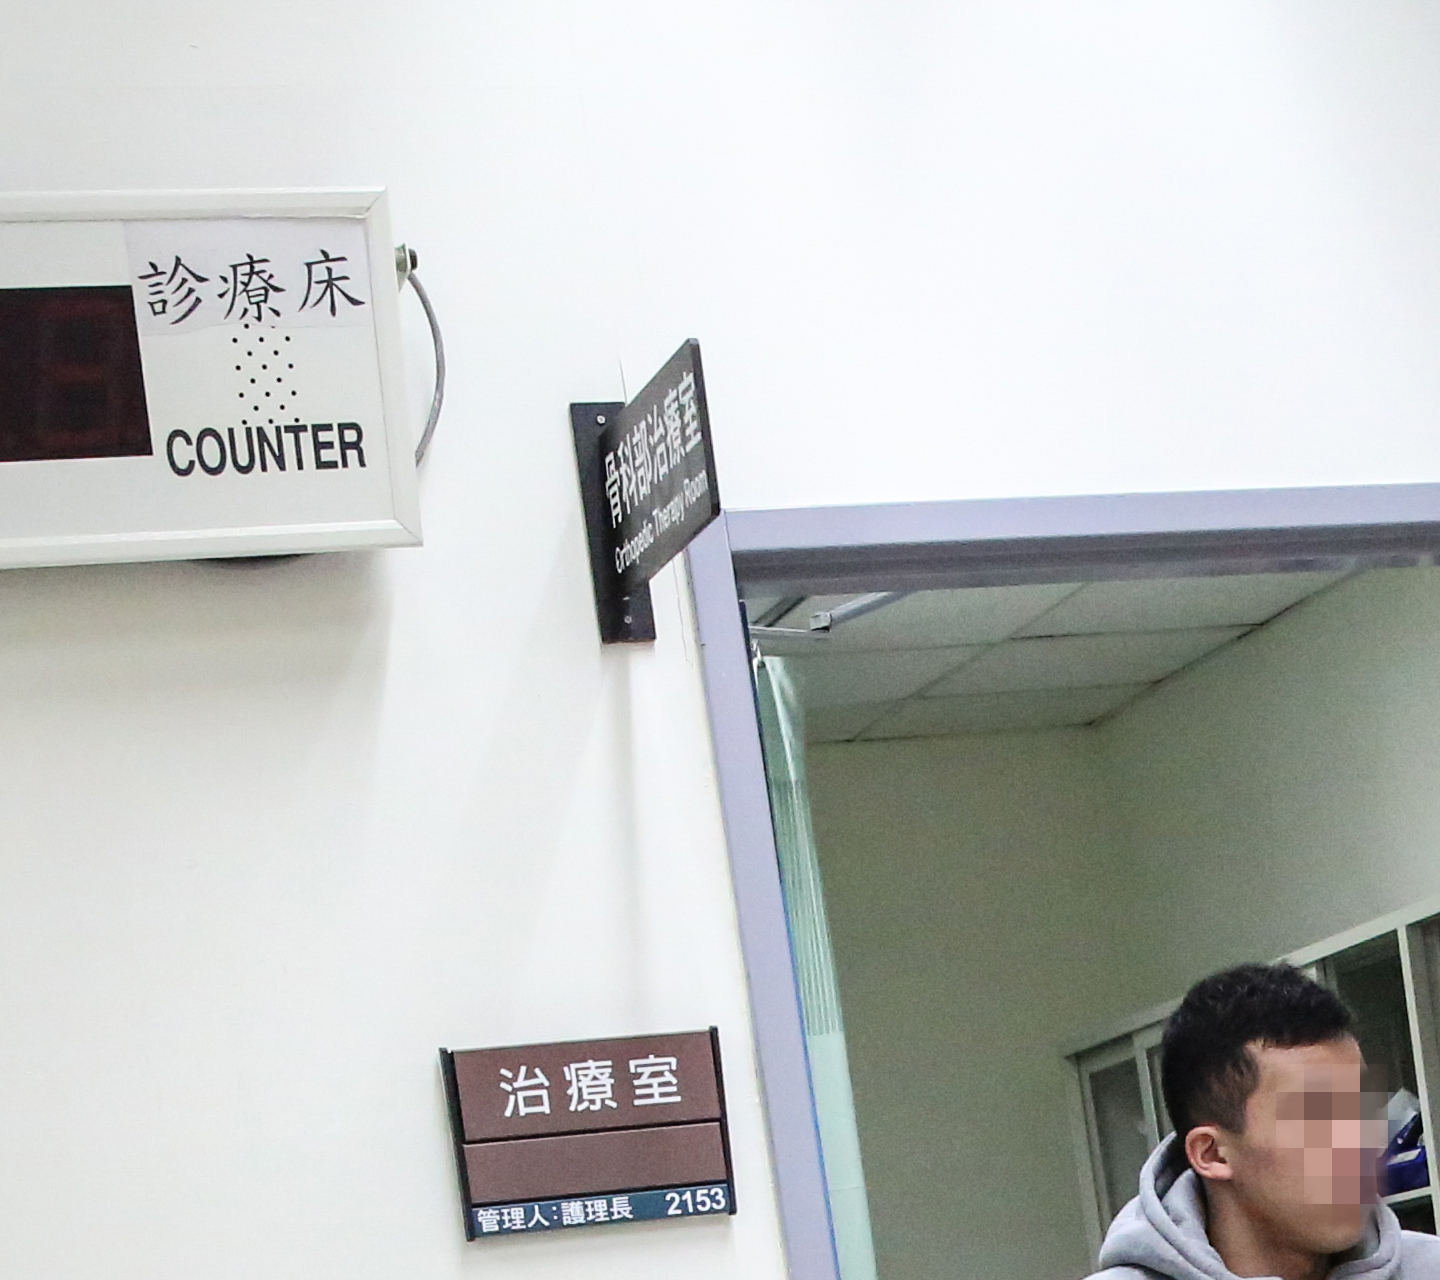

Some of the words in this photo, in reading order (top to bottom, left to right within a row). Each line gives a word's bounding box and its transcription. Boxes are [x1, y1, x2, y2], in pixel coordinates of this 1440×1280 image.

[136, 248, 366, 325] 診療床
[167, 420, 368, 478] COUNTER
[604, 371, 702, 528] 骨科部治療室
[652, 500, 685, 537] Therapy
[683, 469, 709, 508] Room
[498, 1055, 682, 1118] 治療室
[665, 1187, 726, 1216] 2153
